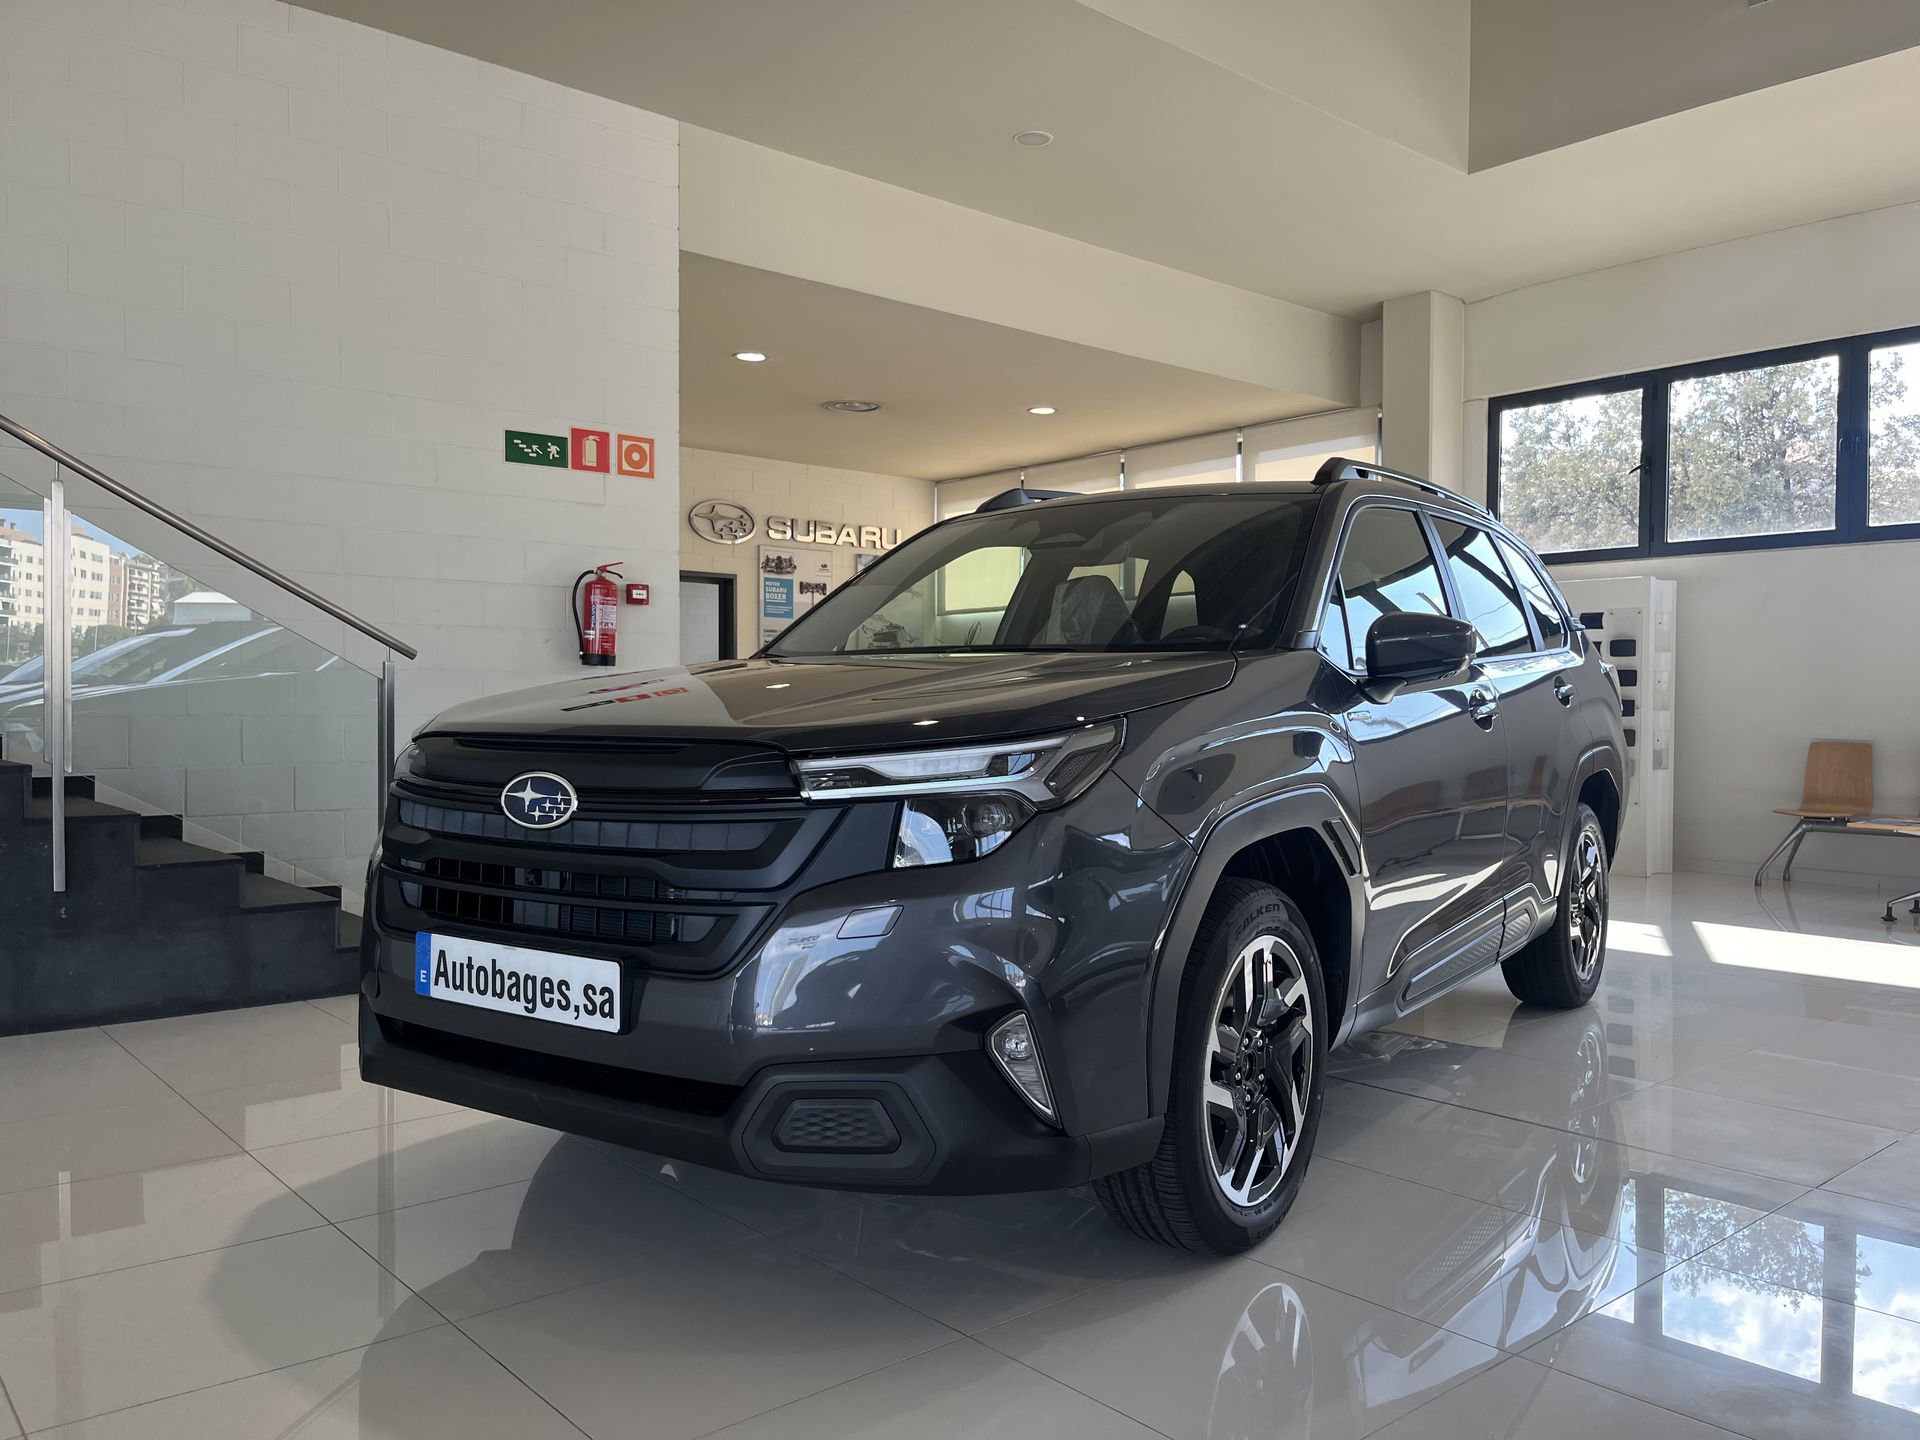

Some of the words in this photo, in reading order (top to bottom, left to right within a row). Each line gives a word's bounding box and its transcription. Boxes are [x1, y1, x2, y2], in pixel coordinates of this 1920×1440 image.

[767, 515, 902, 549] SUBARU
[420, 970, 427, 982] E
[434, 949, 614, 1019] Autobages,sa
